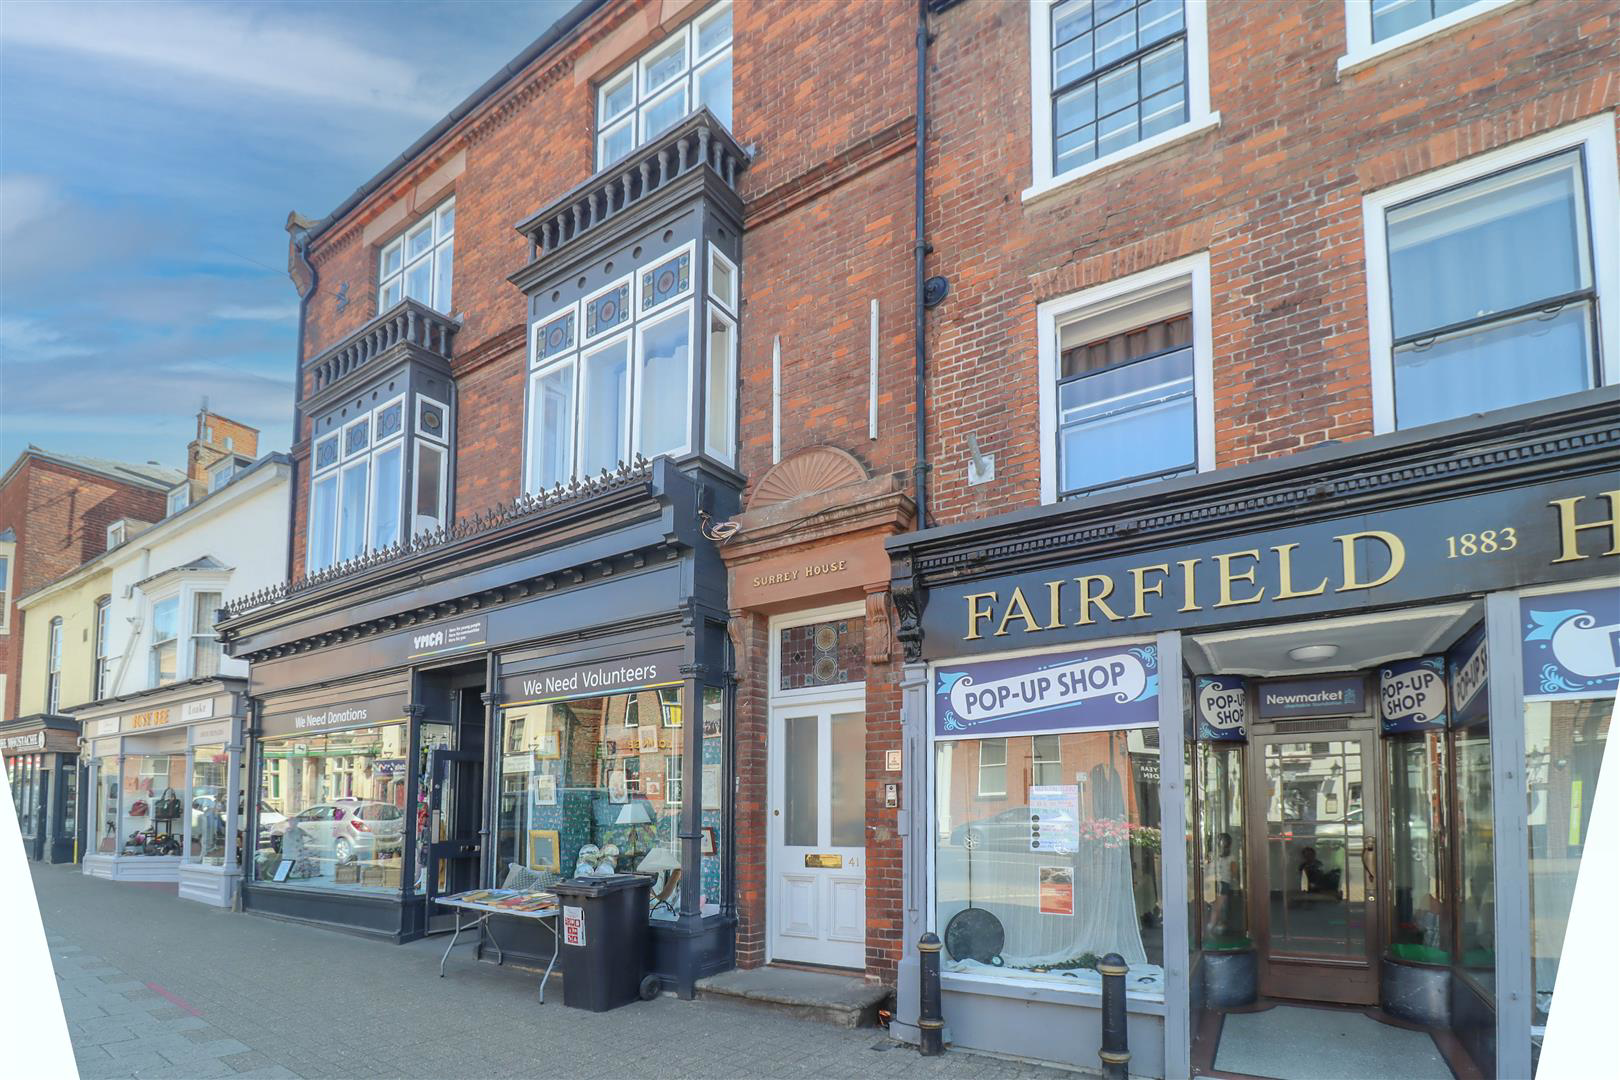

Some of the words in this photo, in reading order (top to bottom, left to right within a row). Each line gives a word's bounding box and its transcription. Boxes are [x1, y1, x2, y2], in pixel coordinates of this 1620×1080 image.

[753, 570, 799, 588] SURREY
[805, 560, 847, 578] HOUSE
[962, 530, 1407, 640] FAIRFIELD
[1445, 527, 1518, 559] 1883
[414, 631, 443, 649] YMCA
[523, 680, 542, 696] We
[545, 672, 578, 693] Need
[582, 664, 657, 688] Volunteers
[965, 676, 1051, 715] POP-UP
[1057, 661, 1126, 697] SHOP
[1382, 673, 1434, 701] POP-UP
[1266, 690, 1343, 705] Newmarket
[1387, 692, 1426, 716] SHOP
[295, 717, 306, 729] We
[306, 712, 326, 727] Need
[328, 708, 368, 724] Donations
[1217, 709, 1244, 725] SHOP
[848, 856, 860, 868] 41
